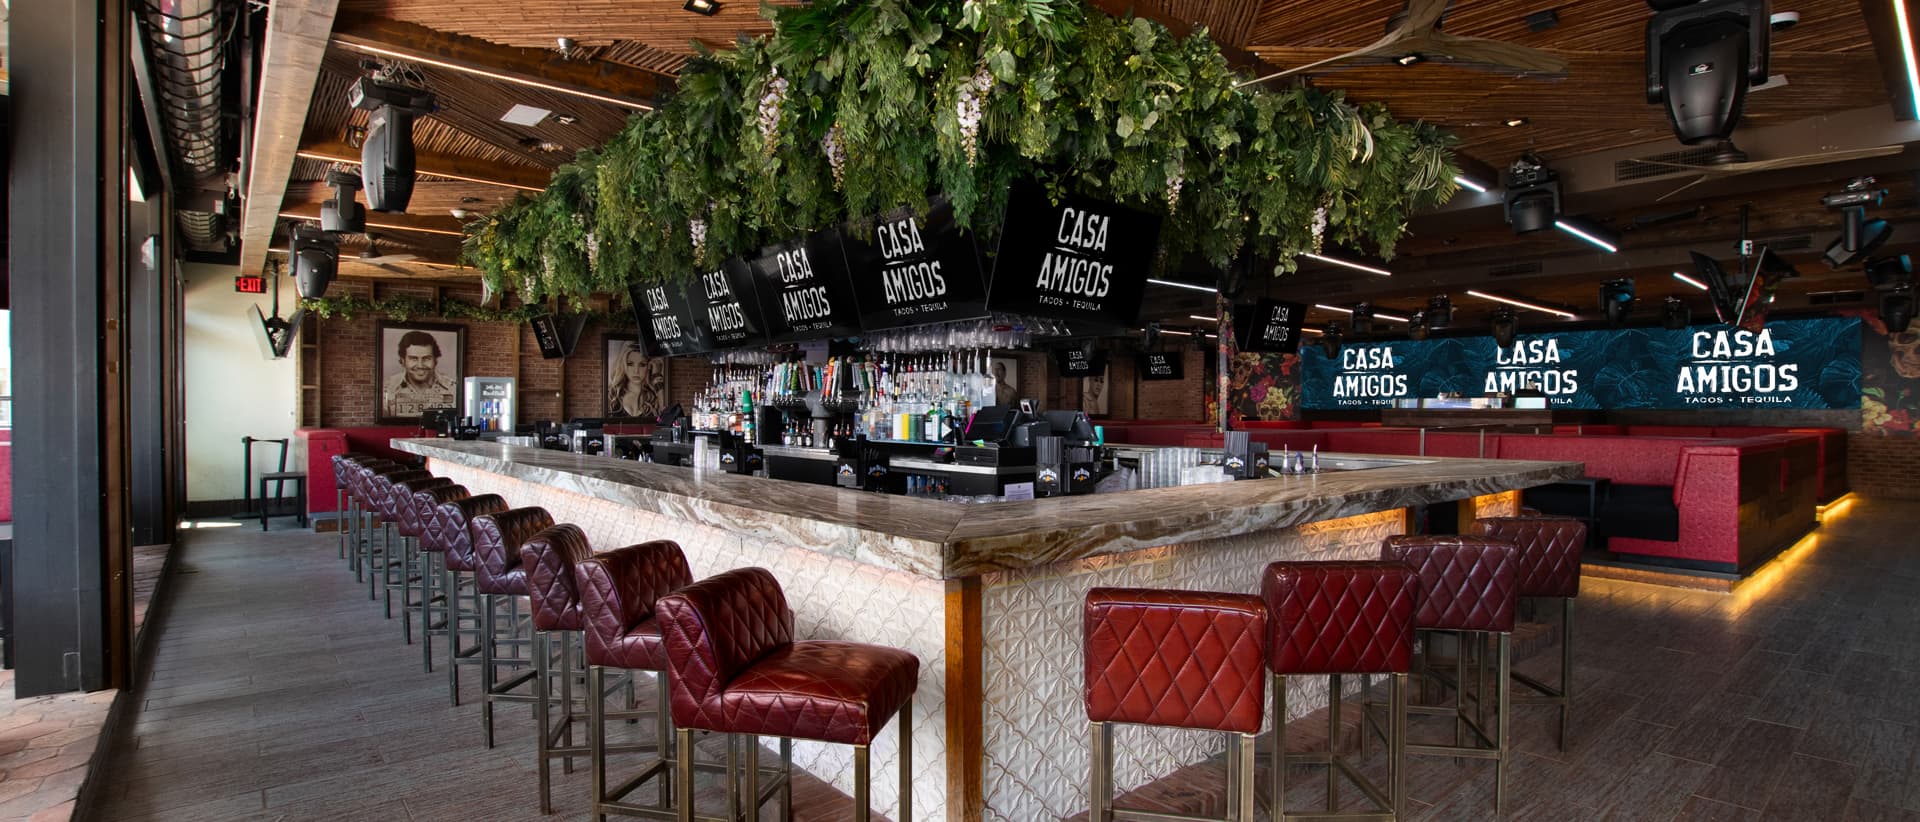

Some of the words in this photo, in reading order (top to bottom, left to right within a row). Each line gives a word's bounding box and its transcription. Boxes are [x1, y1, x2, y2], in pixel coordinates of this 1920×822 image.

[878, 217, 925, 259] CASA
[1058, 207, 1110, 251] CASA
[776, 247, 814, 283] CASA
[1036, 252, 1113, 298] AMIGOS
[240, 277, 262, 292] EXIT
[703, 269, 730, 299] CASA
[882, 260, 946, 304] AMIGOS
[646, 286, 670, 311] CASA
[782, 286, 831, 322] AMIGOS
[893, 306, 915, 316] TACOS
[1039, 295, 1063, 306] TACOS
[1073, 300, 1101, 311] TEQUILA
[708, 302, 744, 332] AMIGOS
[1271, 305, 1289, 322] CASA
[652, 315, 681, 340] AMIGOS
[1263, 324, 1290, 342] AMIGOS
[1496, 338, 1561, 365] CASA
[1692, 328, 1775, 358] CASA
[1343, 346, 1394, 370] CASA
[1332, 374, 1408, 398] AMIGOS
[1484, 369, 1578, 395] AMIGOS
[1677, 363, 1799, 393] AMIGOS
[1550, 397, 1573, 405] UILA
[1740, 396, 1792, 404] TEQUILA
